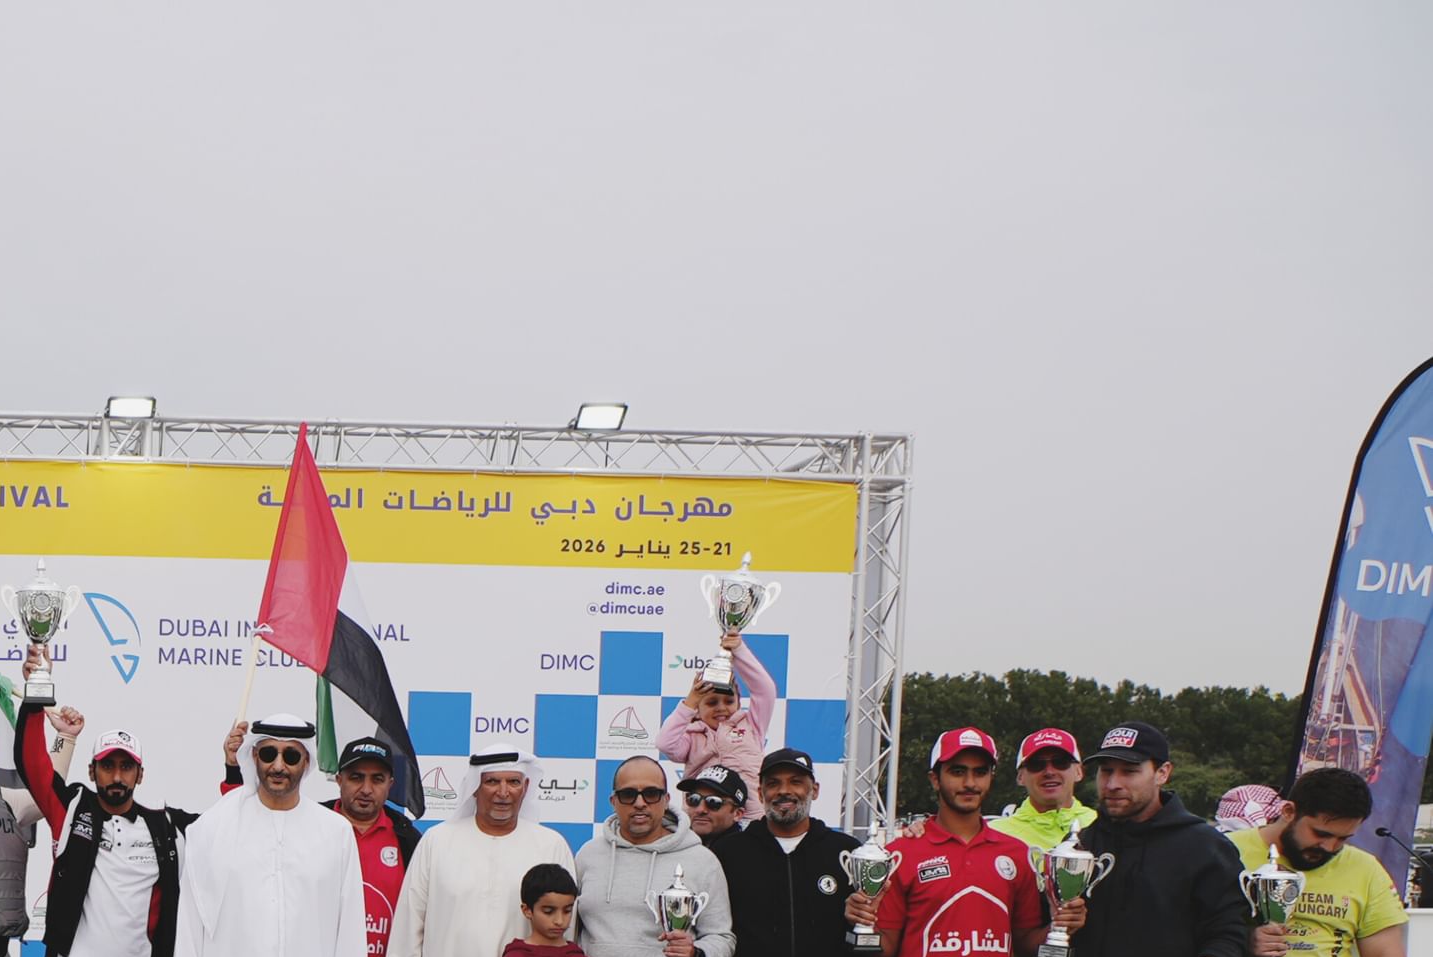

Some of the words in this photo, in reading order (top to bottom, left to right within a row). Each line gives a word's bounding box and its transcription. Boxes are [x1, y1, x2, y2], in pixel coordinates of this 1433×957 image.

[382, 489, 512, 519] للرياضات
[530, 497, 597, 526] دبي
[615, 495, 733, 522] مهرجان
[560, 538, 606, 553] 2026
[615, 539, 671, 559] يناير
[1356, 559, 1433, 597] DIM
[605, 582, 665, 597] dimc.ae
[586, 601, 664, 616] @dimcuae
[159, 619, 228, 638] DUBAI
[158, 648, 243, 667] MARINE
[540, 653, 595, 671] DIMC
[668, 655, 715, 670] Duba
[474, 716, 530, 734] DIMC
[1301, 893, 1334, 905] TEAM
[929, 929, 1009, 956] لشارقة
